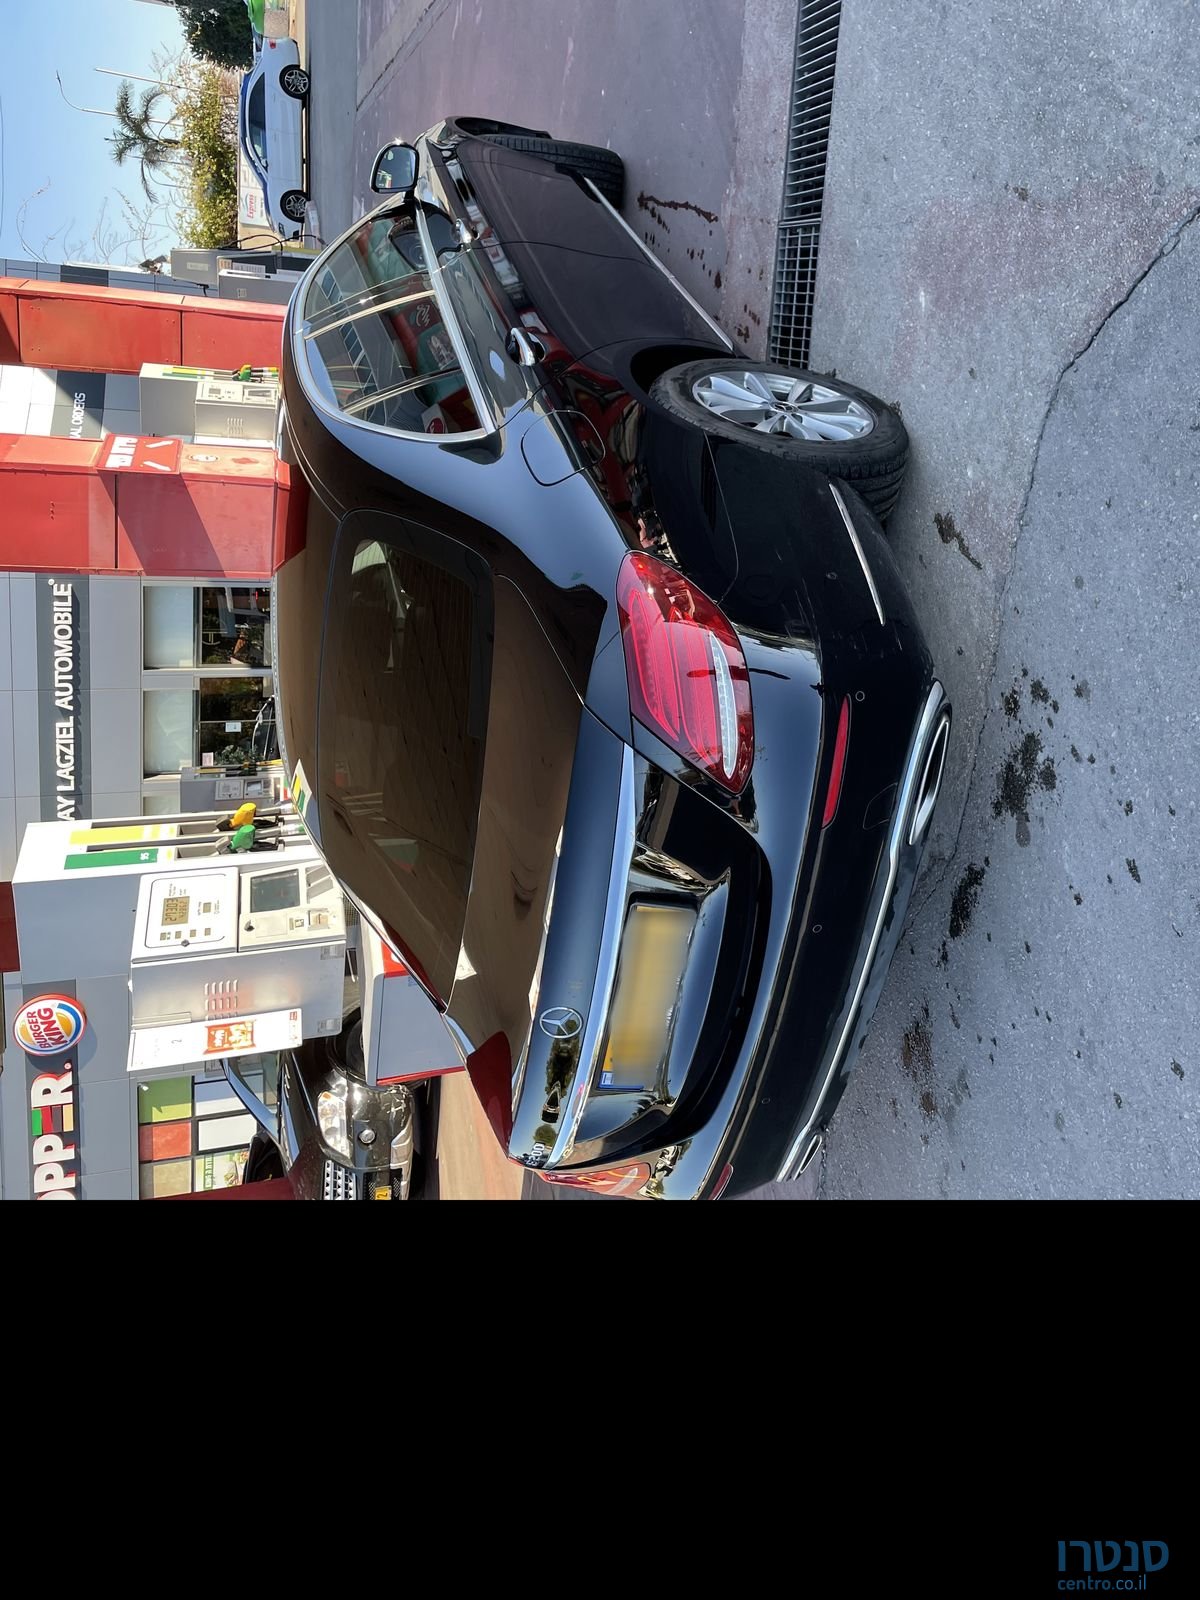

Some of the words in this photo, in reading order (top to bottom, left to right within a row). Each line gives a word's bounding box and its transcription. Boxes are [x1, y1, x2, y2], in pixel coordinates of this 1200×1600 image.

[71, 393, 86, 425] ORDERS
[53, 583, 73, 710] AUTOMOBILE
[56, 716, 74, 791] LAGZIEL
[27, 1011, 52, 1048] BURGER
[38, 1008, 67, 1045] KING
[31, 1071, 76, 1200] PPER
